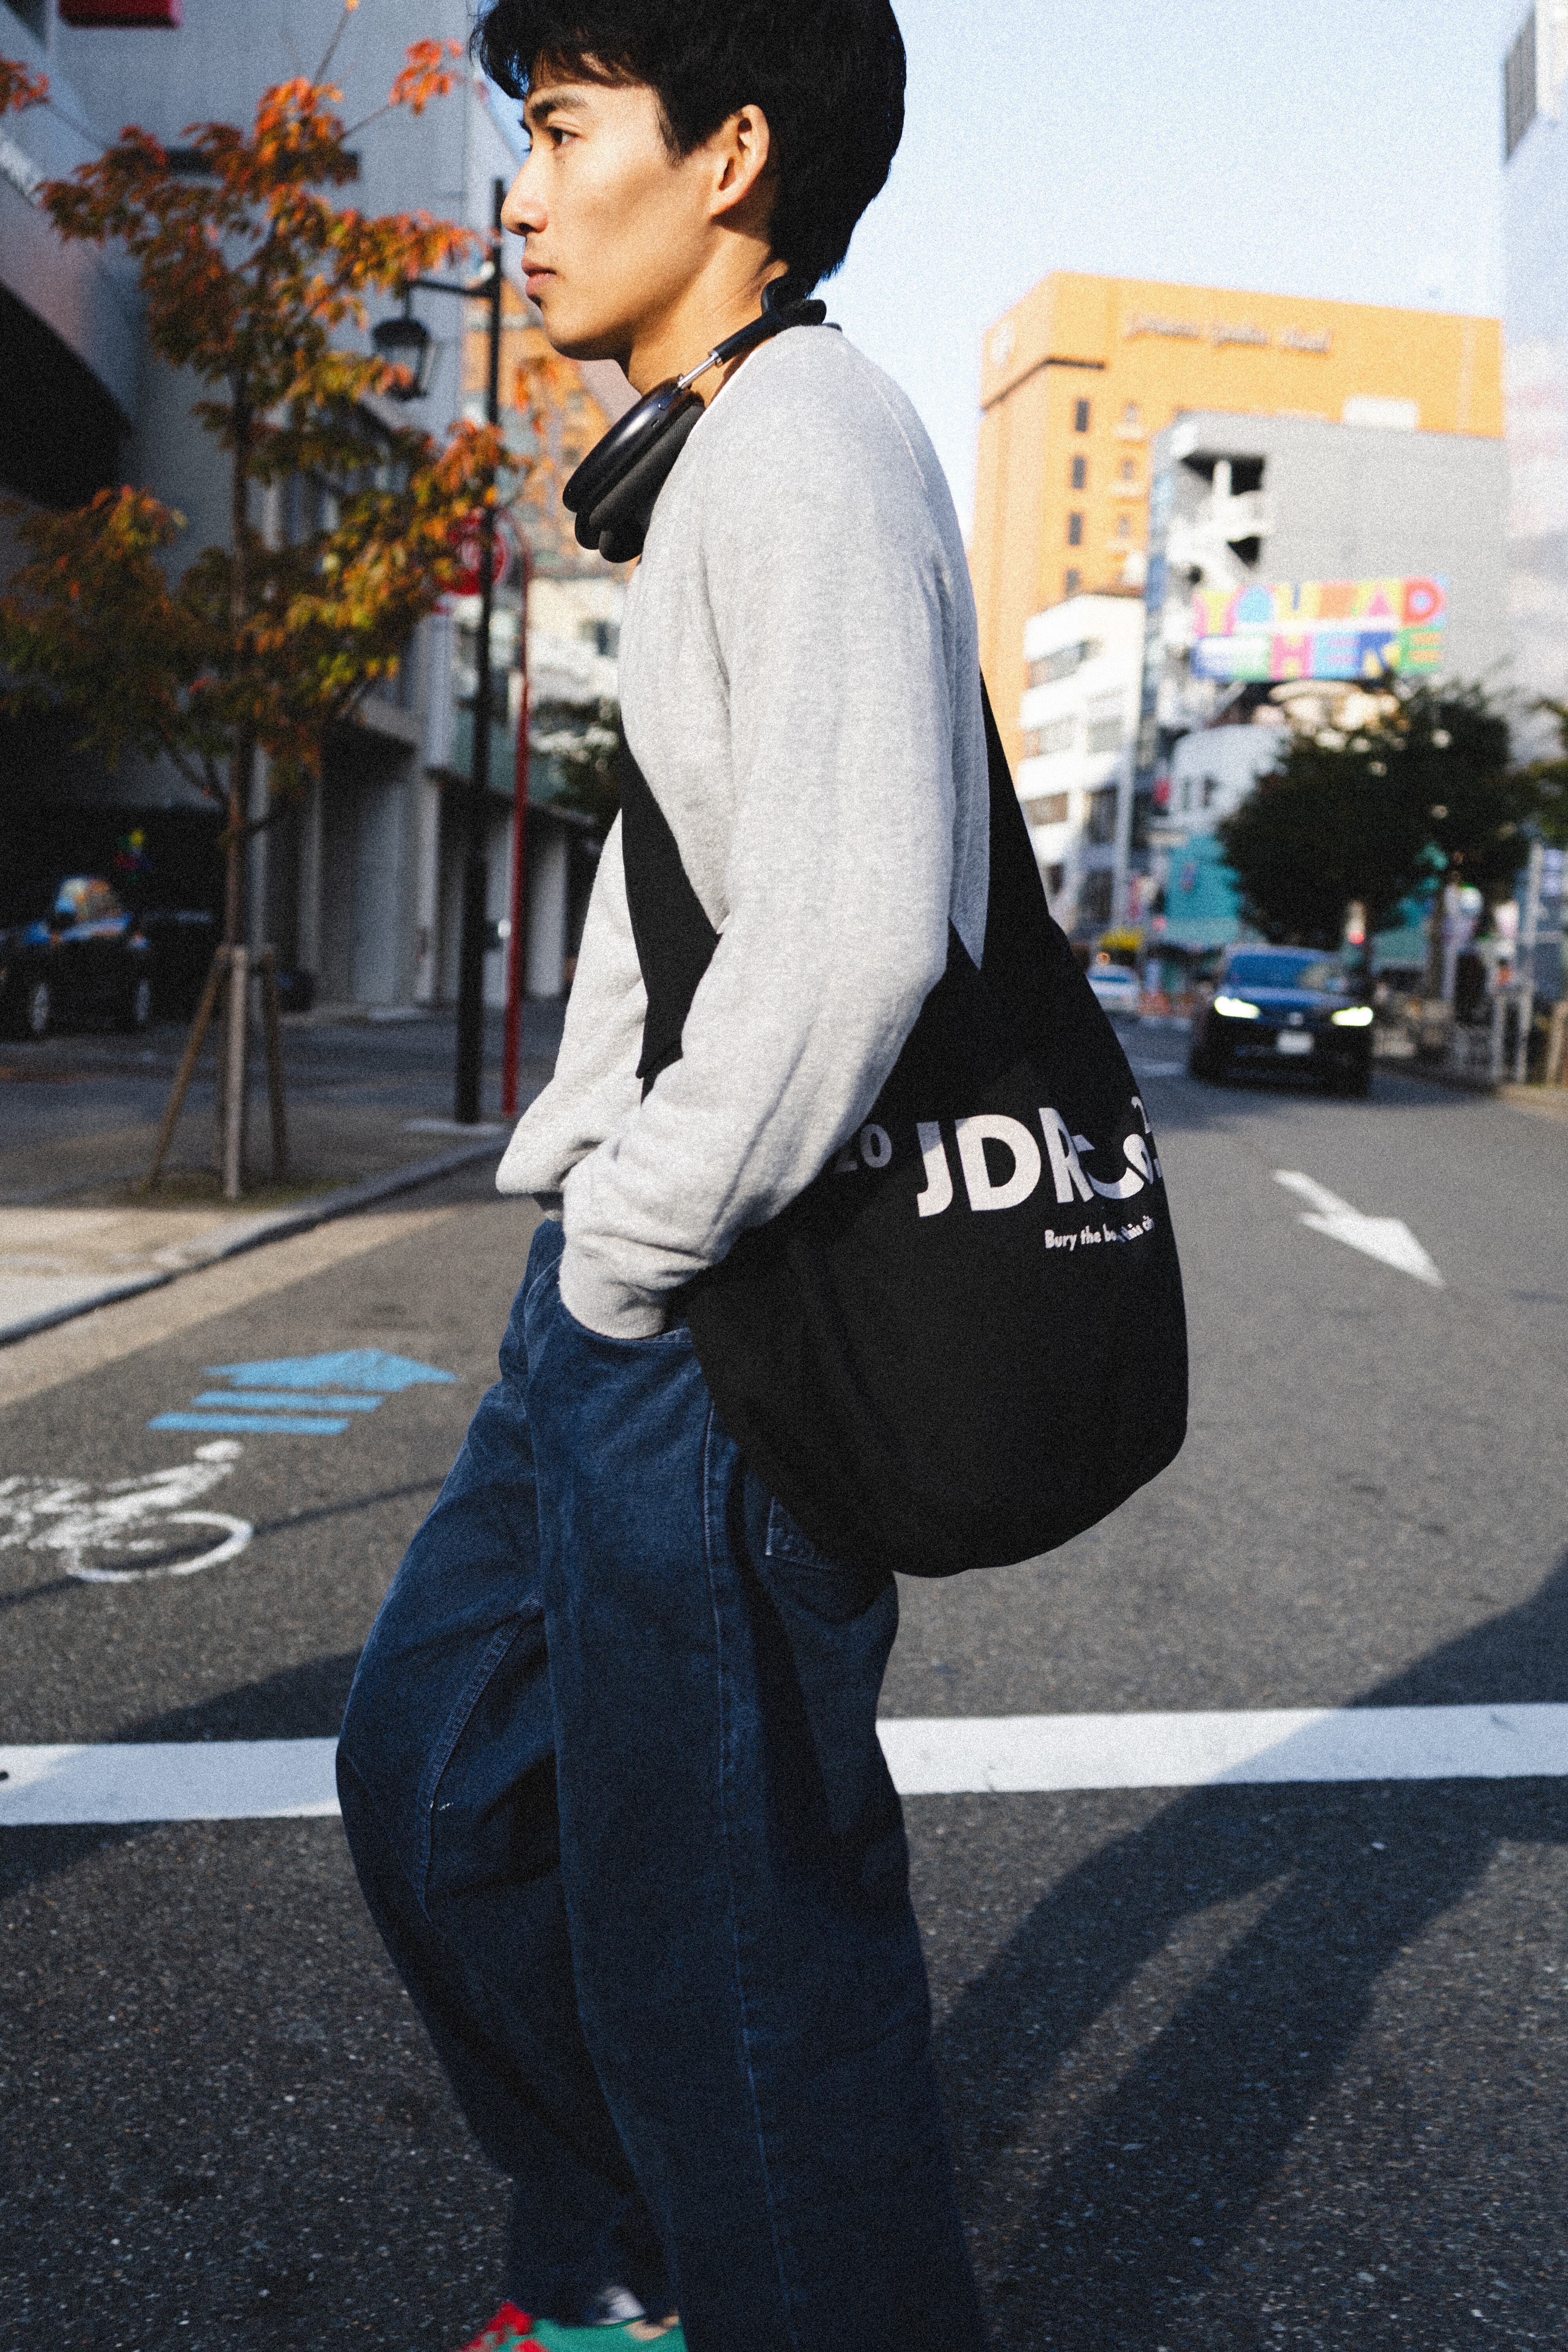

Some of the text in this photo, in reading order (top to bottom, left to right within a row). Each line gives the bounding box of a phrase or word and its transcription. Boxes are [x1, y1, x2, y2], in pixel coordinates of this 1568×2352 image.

[1270, 628, 1443, 681] HERE
[1044, 1229, 1078, 1251] Bury
[1081, 1225, 1102, 1245] the
